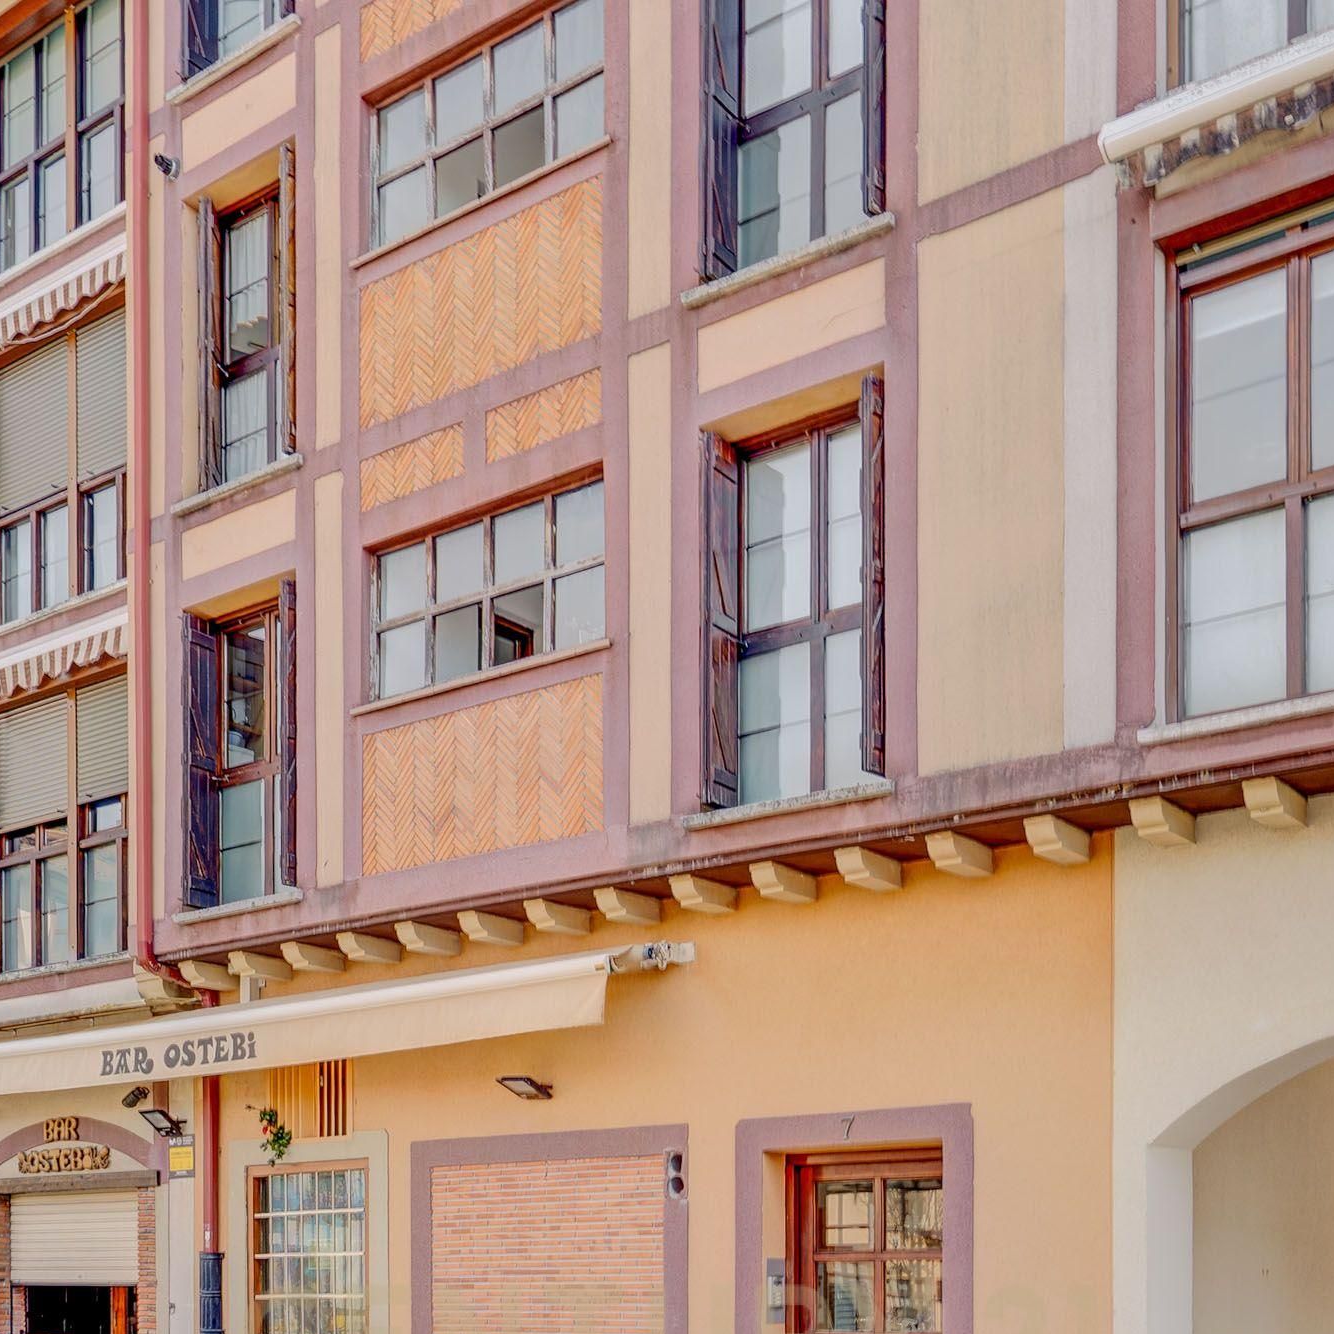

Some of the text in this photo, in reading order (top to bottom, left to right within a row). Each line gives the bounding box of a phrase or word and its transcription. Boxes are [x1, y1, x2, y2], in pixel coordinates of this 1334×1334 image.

[100, 1046, 155, 1076] BAR
[42, 1115, 80, 1142] BAR
[840, 1112, 856, 1142] 7
